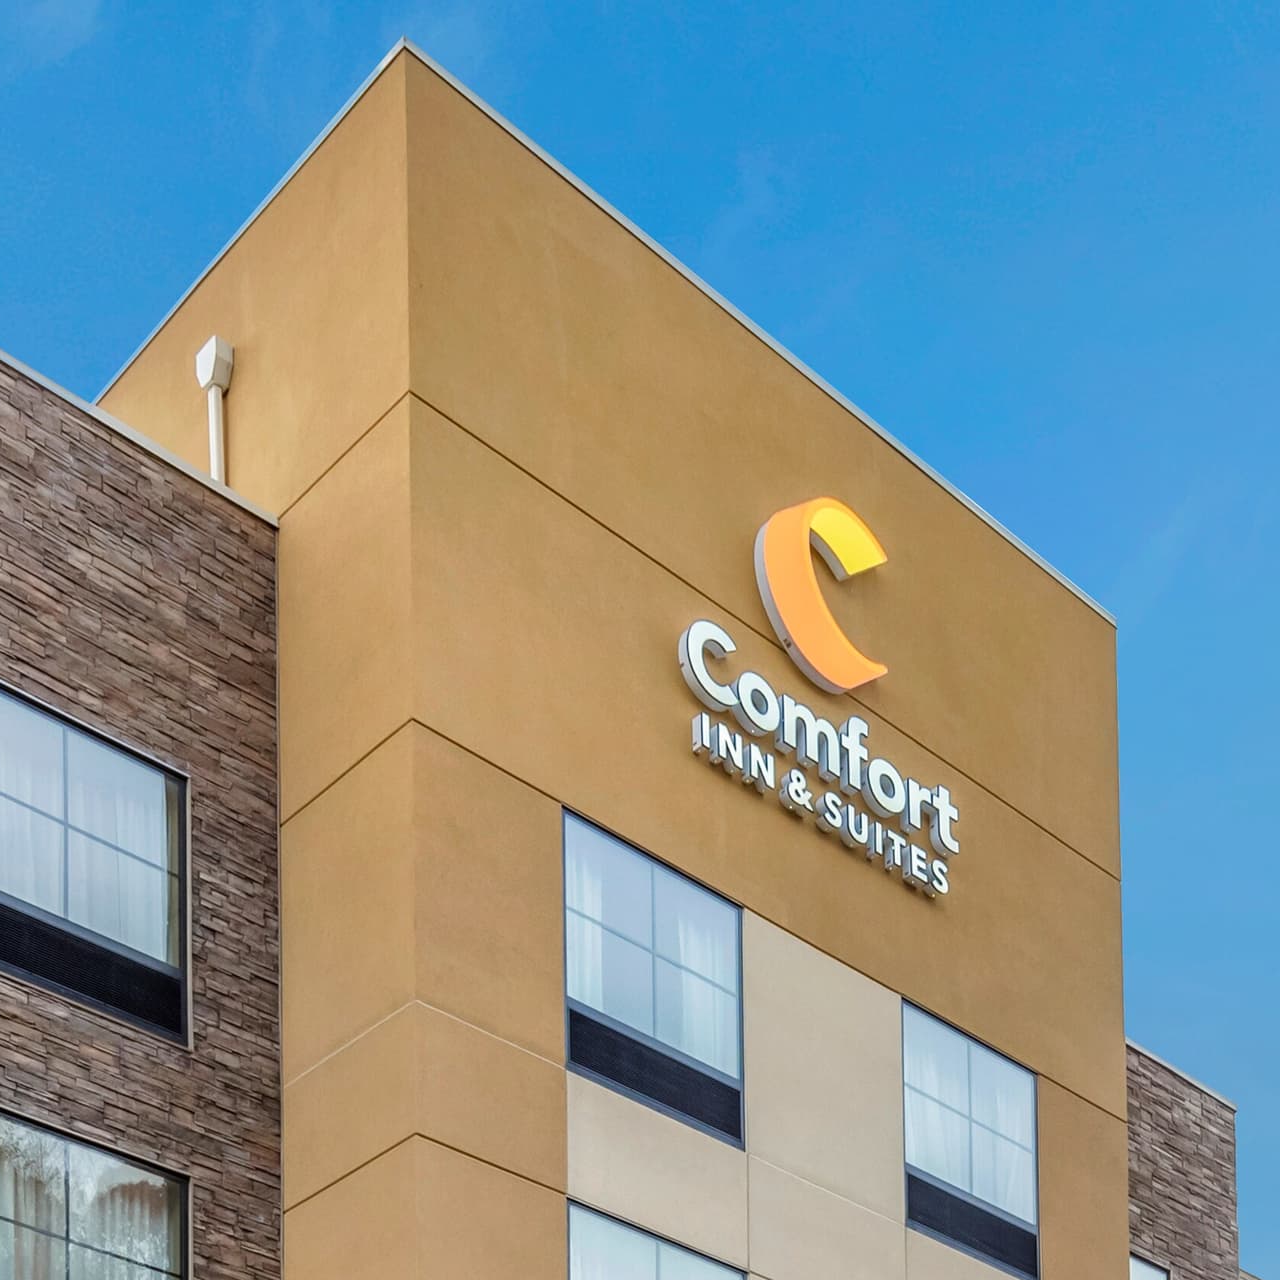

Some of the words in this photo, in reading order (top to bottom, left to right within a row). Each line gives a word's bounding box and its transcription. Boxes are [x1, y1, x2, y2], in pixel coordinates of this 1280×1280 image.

[678, 618, 960, 857] Comfort
[691, 711, 775, 794] INN
[779, 768, 814, 819] &
[816, 791, 950, 899] SUITES
